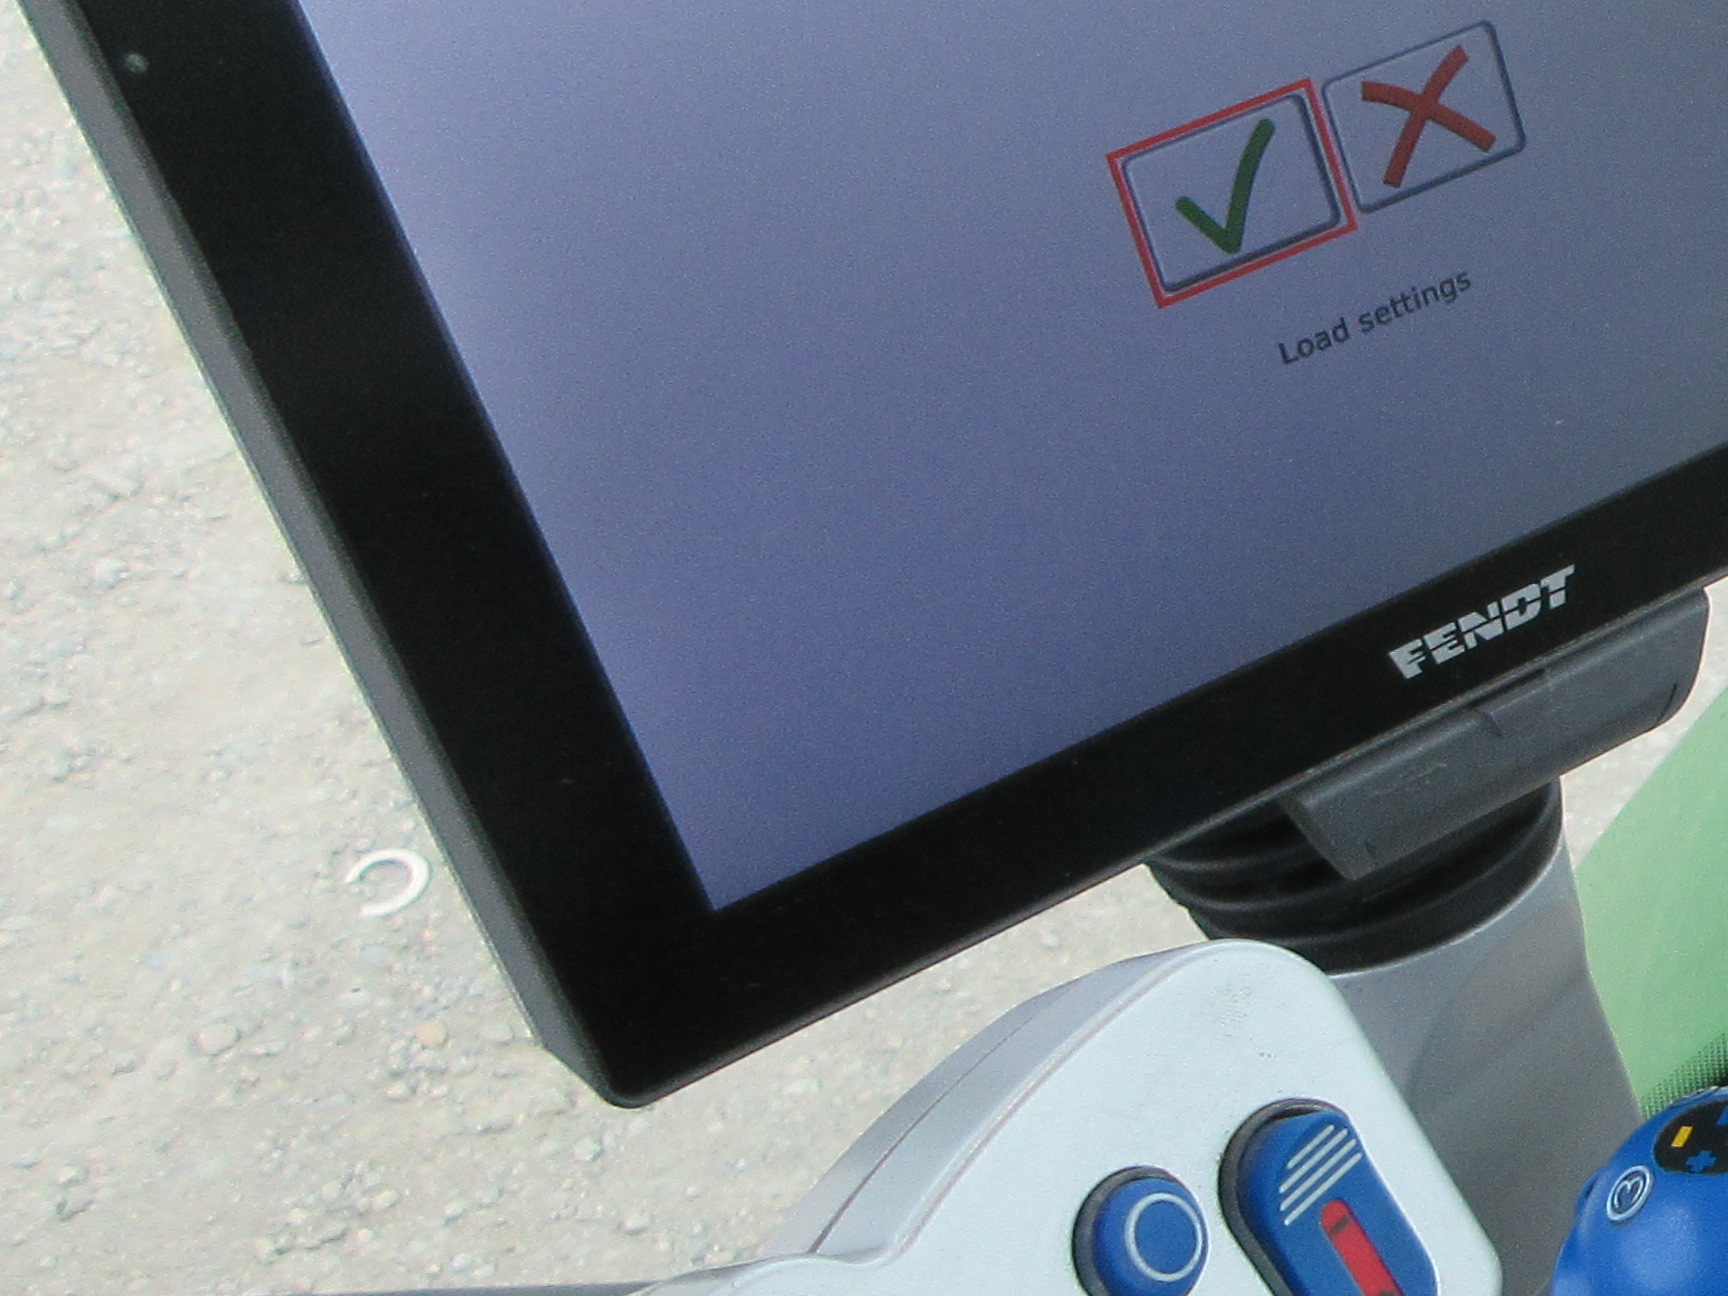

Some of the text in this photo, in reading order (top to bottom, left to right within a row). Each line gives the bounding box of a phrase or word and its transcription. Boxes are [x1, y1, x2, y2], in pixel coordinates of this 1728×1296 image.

[1277, 268, 1473, 366] Load settings
[1388, 563, 1575, 679] FENDT
